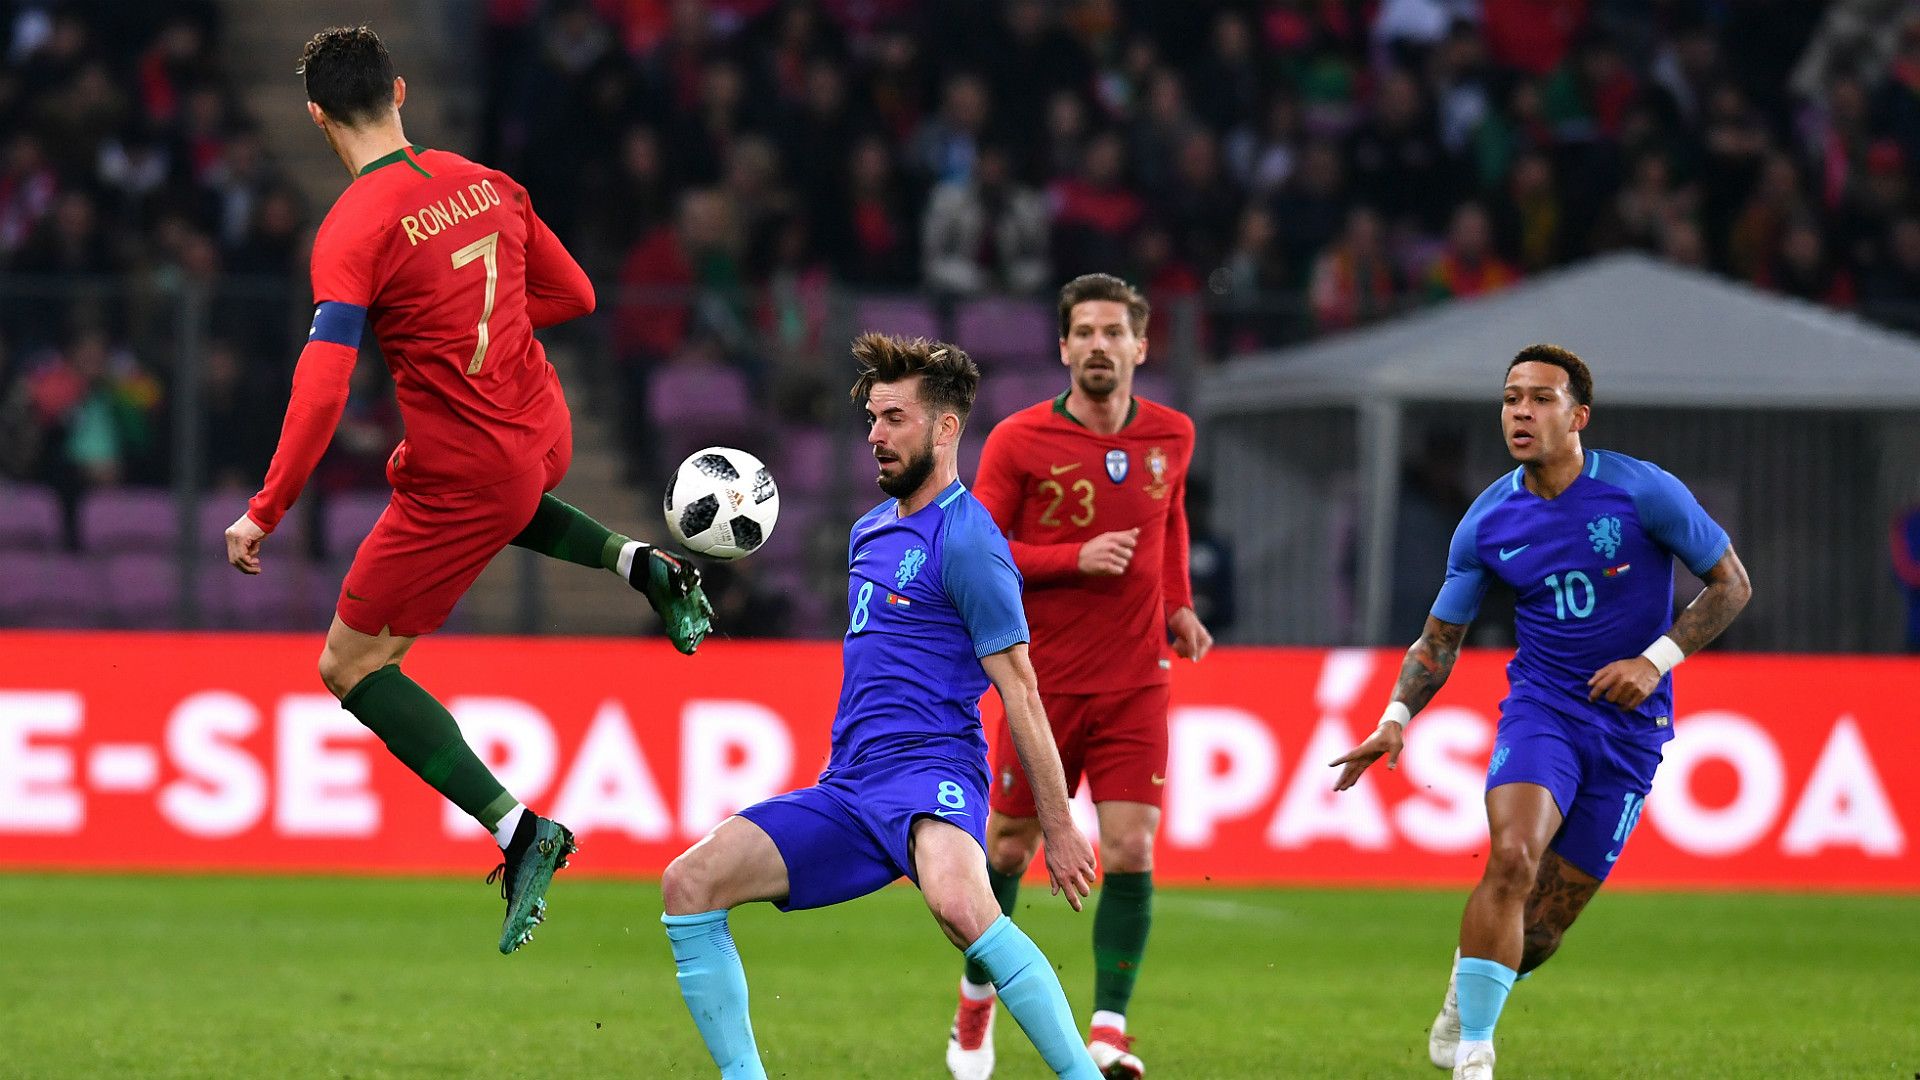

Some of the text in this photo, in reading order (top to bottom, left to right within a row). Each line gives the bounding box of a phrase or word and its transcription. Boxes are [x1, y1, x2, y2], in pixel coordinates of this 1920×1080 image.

[400, 178, 501, 247] RONALDO
[450, 230, 500, 376] 7
[1037, 478, 1095, 527] 23
[850, 580, 874, 635] 8
[1544, 570, 1595, 620] 10
[441, 695, 797, 844] PAR
[936, 780, 966, 810] 8
